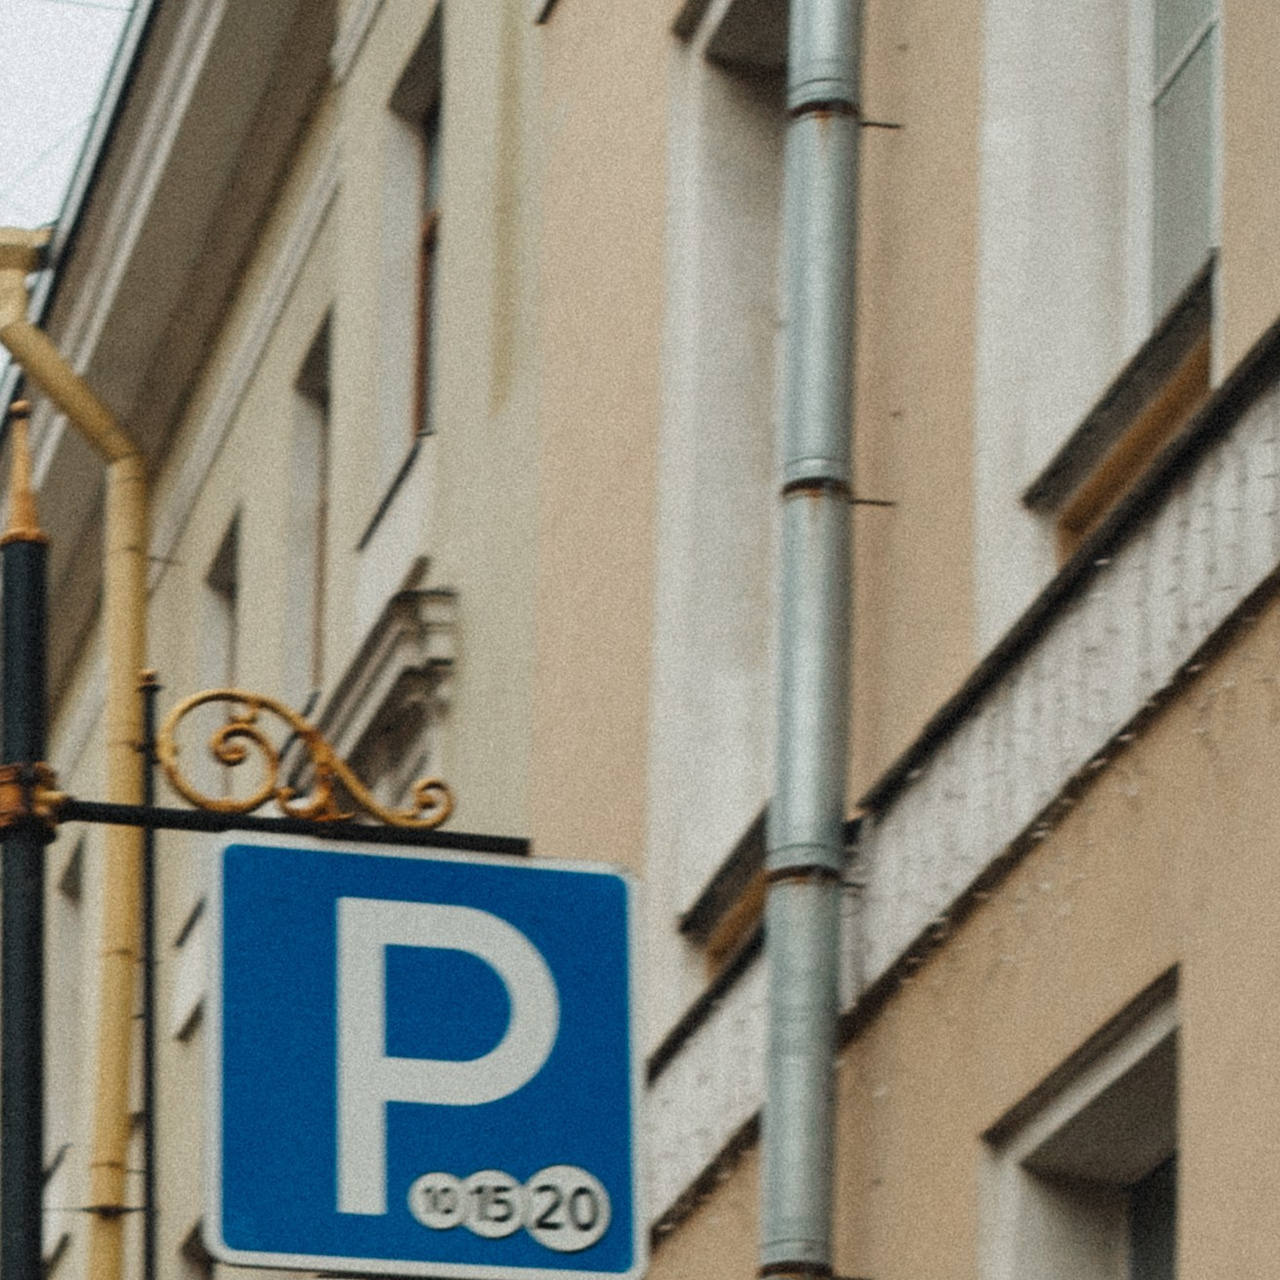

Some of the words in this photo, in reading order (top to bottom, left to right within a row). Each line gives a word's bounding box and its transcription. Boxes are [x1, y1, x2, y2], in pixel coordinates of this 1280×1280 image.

[336, 896, 560, 1215] P
[471, 1185, 514, 1223] 15
[533, 1184, 598, 1232] 20
